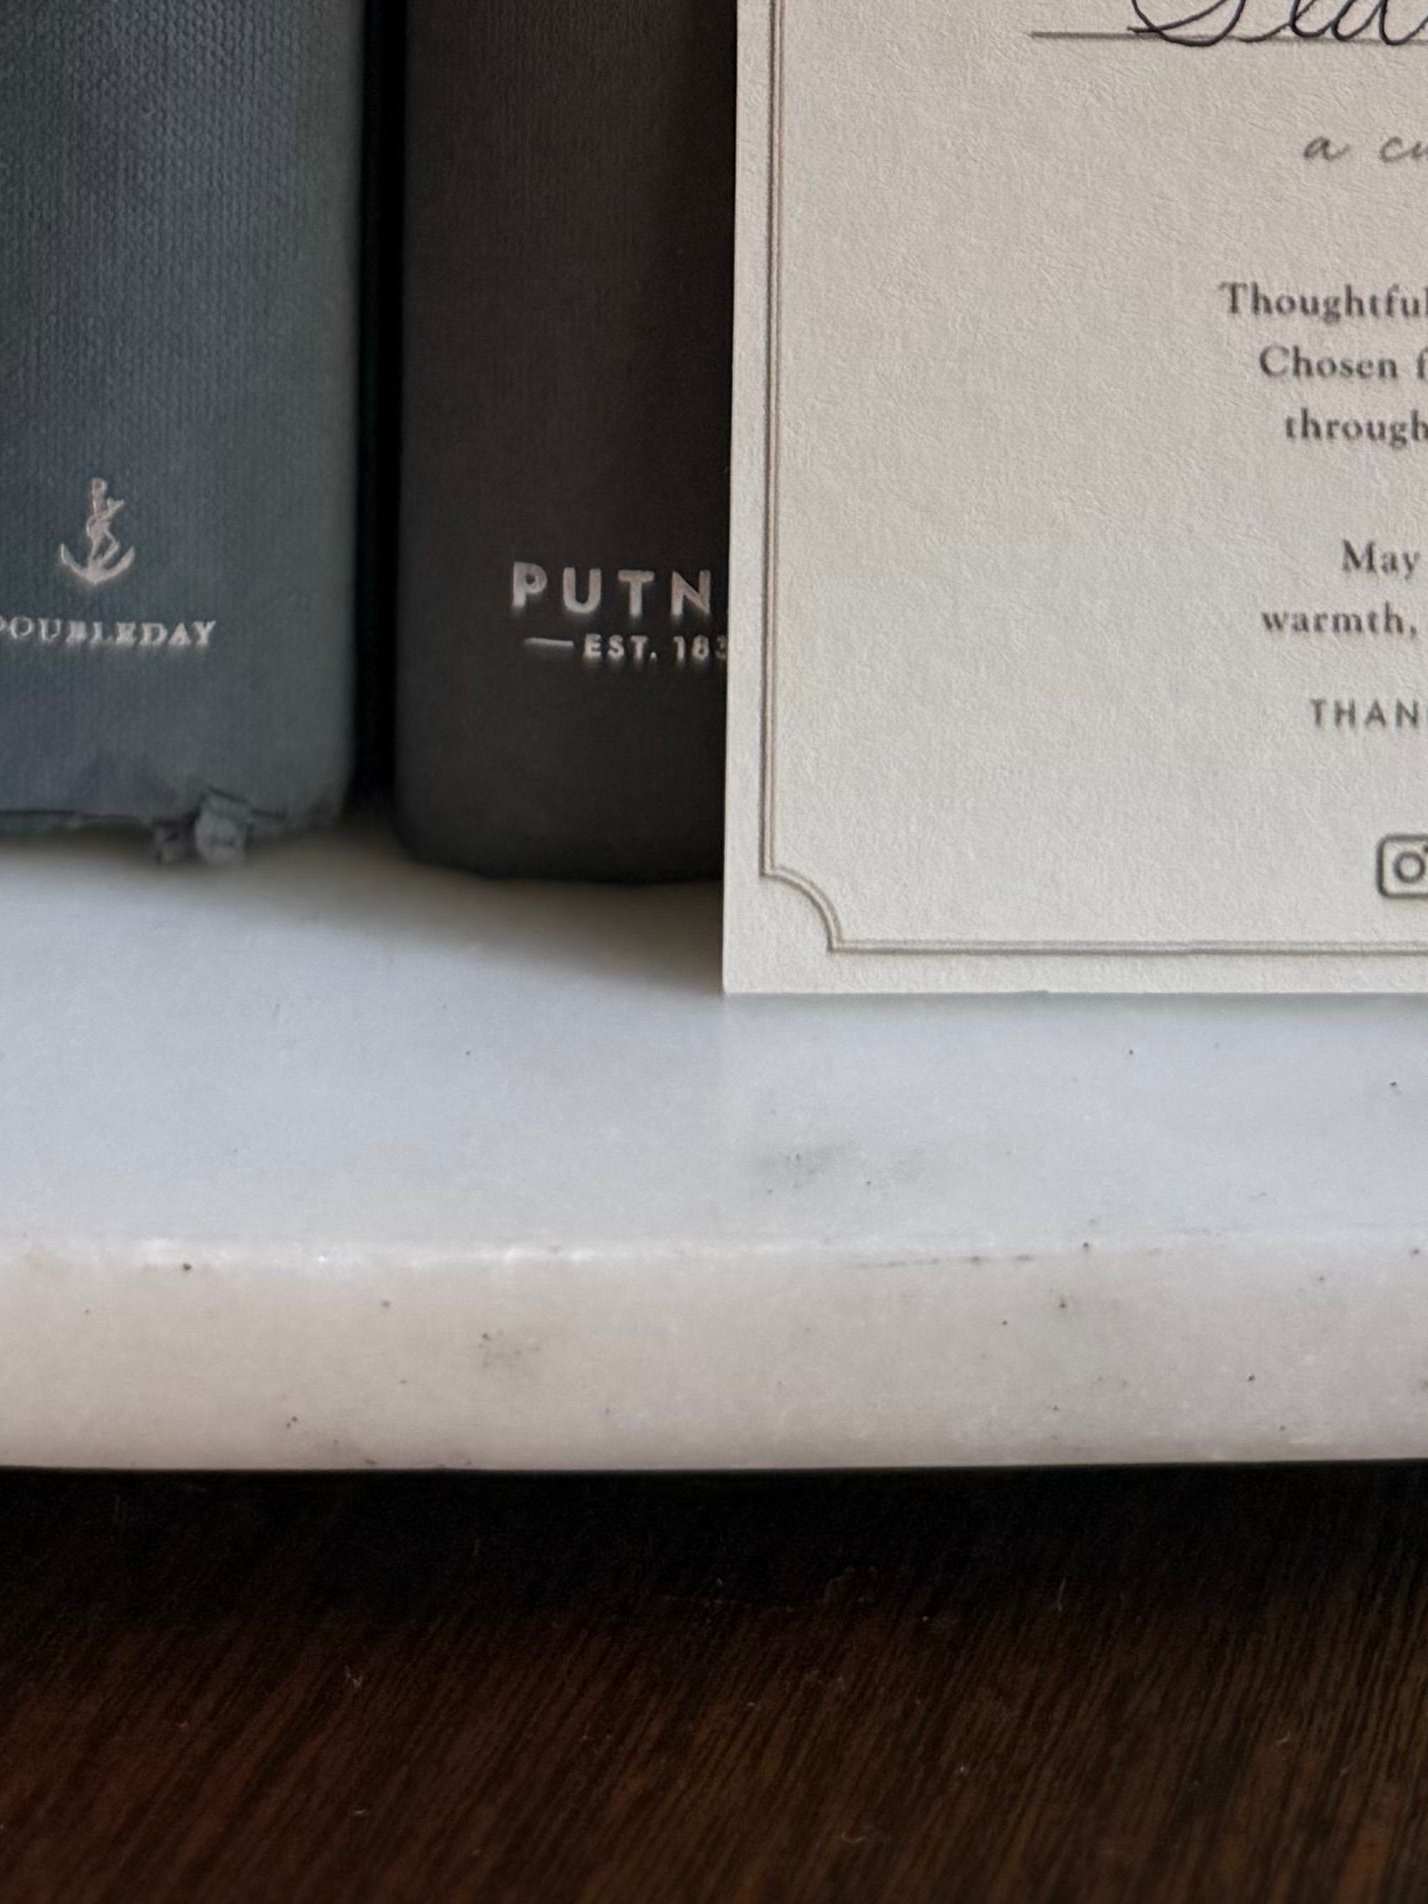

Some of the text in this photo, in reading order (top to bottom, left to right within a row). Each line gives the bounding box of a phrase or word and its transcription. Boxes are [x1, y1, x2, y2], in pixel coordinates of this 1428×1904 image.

[1301, 135, 1351, 163] a
[1258, 345, 1399, 381] Chosen
[1342, 539, 1419, 580] May
[511, 560, 712, 617] PUTN
[1261, 601, 1417, 639] warmth,
[582, 632, 658, 663] EST.
